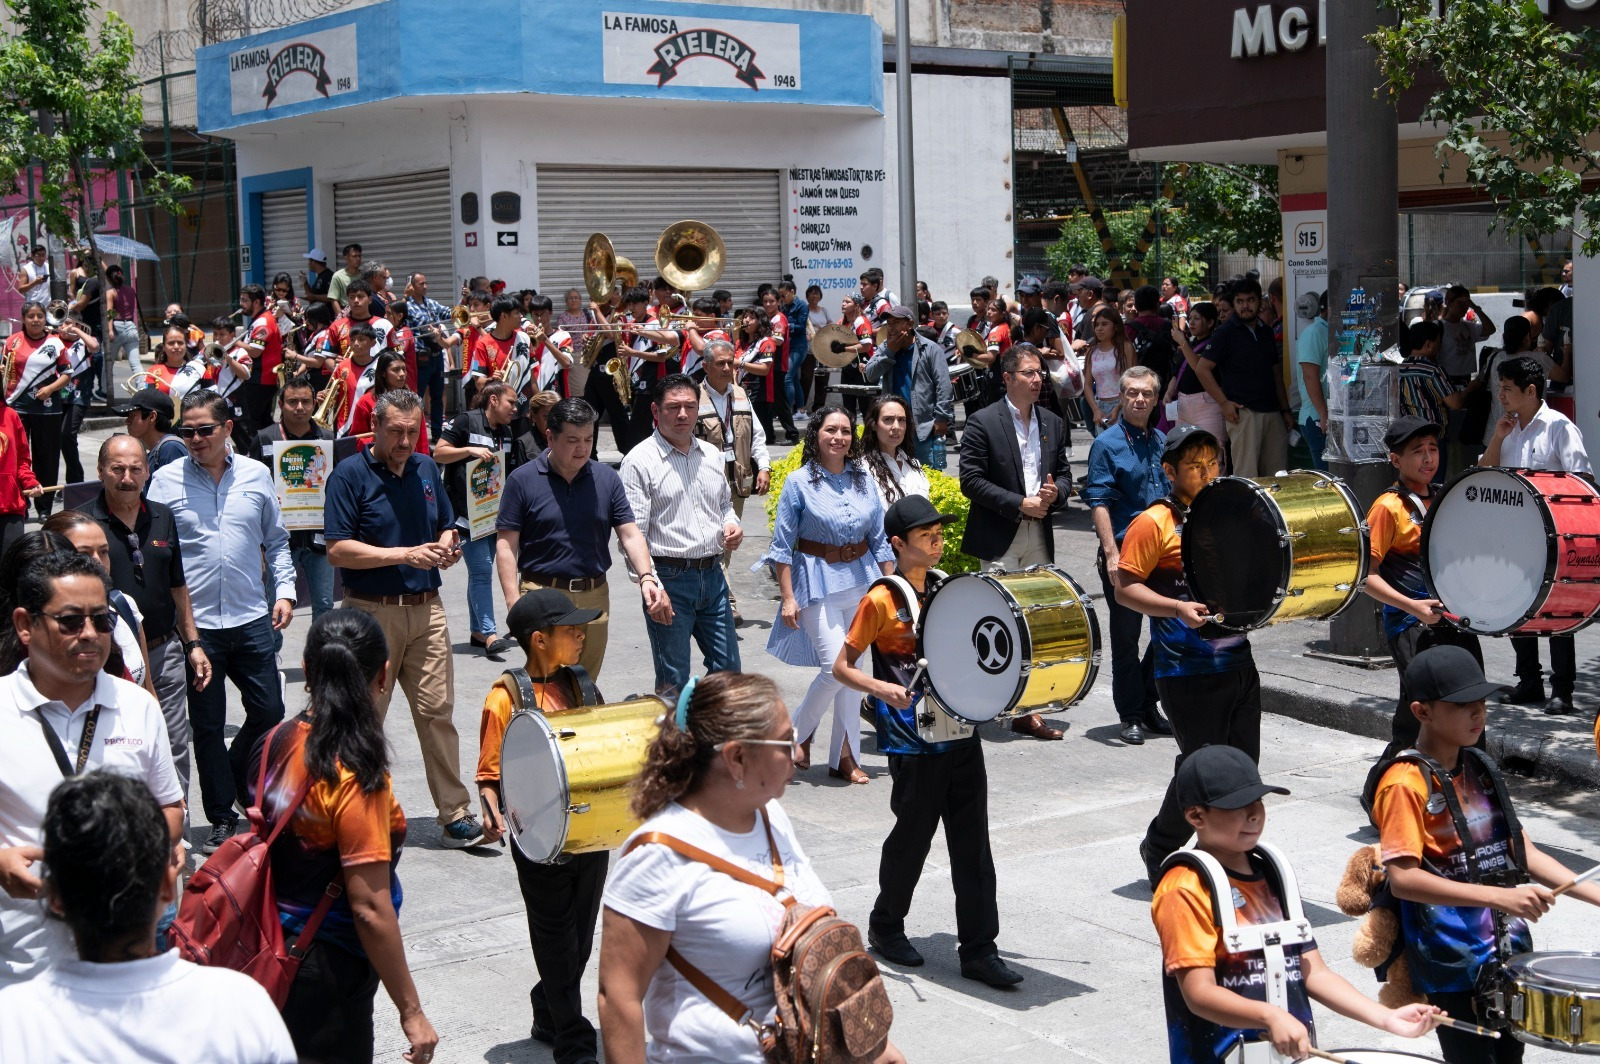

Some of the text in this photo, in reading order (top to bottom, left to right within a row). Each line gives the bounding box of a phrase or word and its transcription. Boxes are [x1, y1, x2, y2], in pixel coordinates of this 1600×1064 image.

[604, 15, 679, 35] LA FAMOSA
[658, 31, 751, 72] RIELERA
[231, 48, 271, 72] LA FAMOSA
[268, 46, 321, 86] RIELERA
[336, 77, 351, 91] 1948
[773, 75, 796, 88] 1948
[789, 168, 821, 182] NUESTRAS
[821, 168, 849, 181] FAMOSAS
[848, 168, 874, 183] TORTAS
[800, 184, 860, 199] JAMÓN CON QUESO
[800, 205, 858, 217] CARNE ENCHILADA
[800, 222, 830, 235] CHORIZO
[1298, 230, 1317, 247] $15
[801, 241, 830, 253] CHORIZO
[790, 256, 808, 269] TEL.
[1287, 259, 1305, 267] Cono
[1479, 486, 1524, 507] YAMAHA
